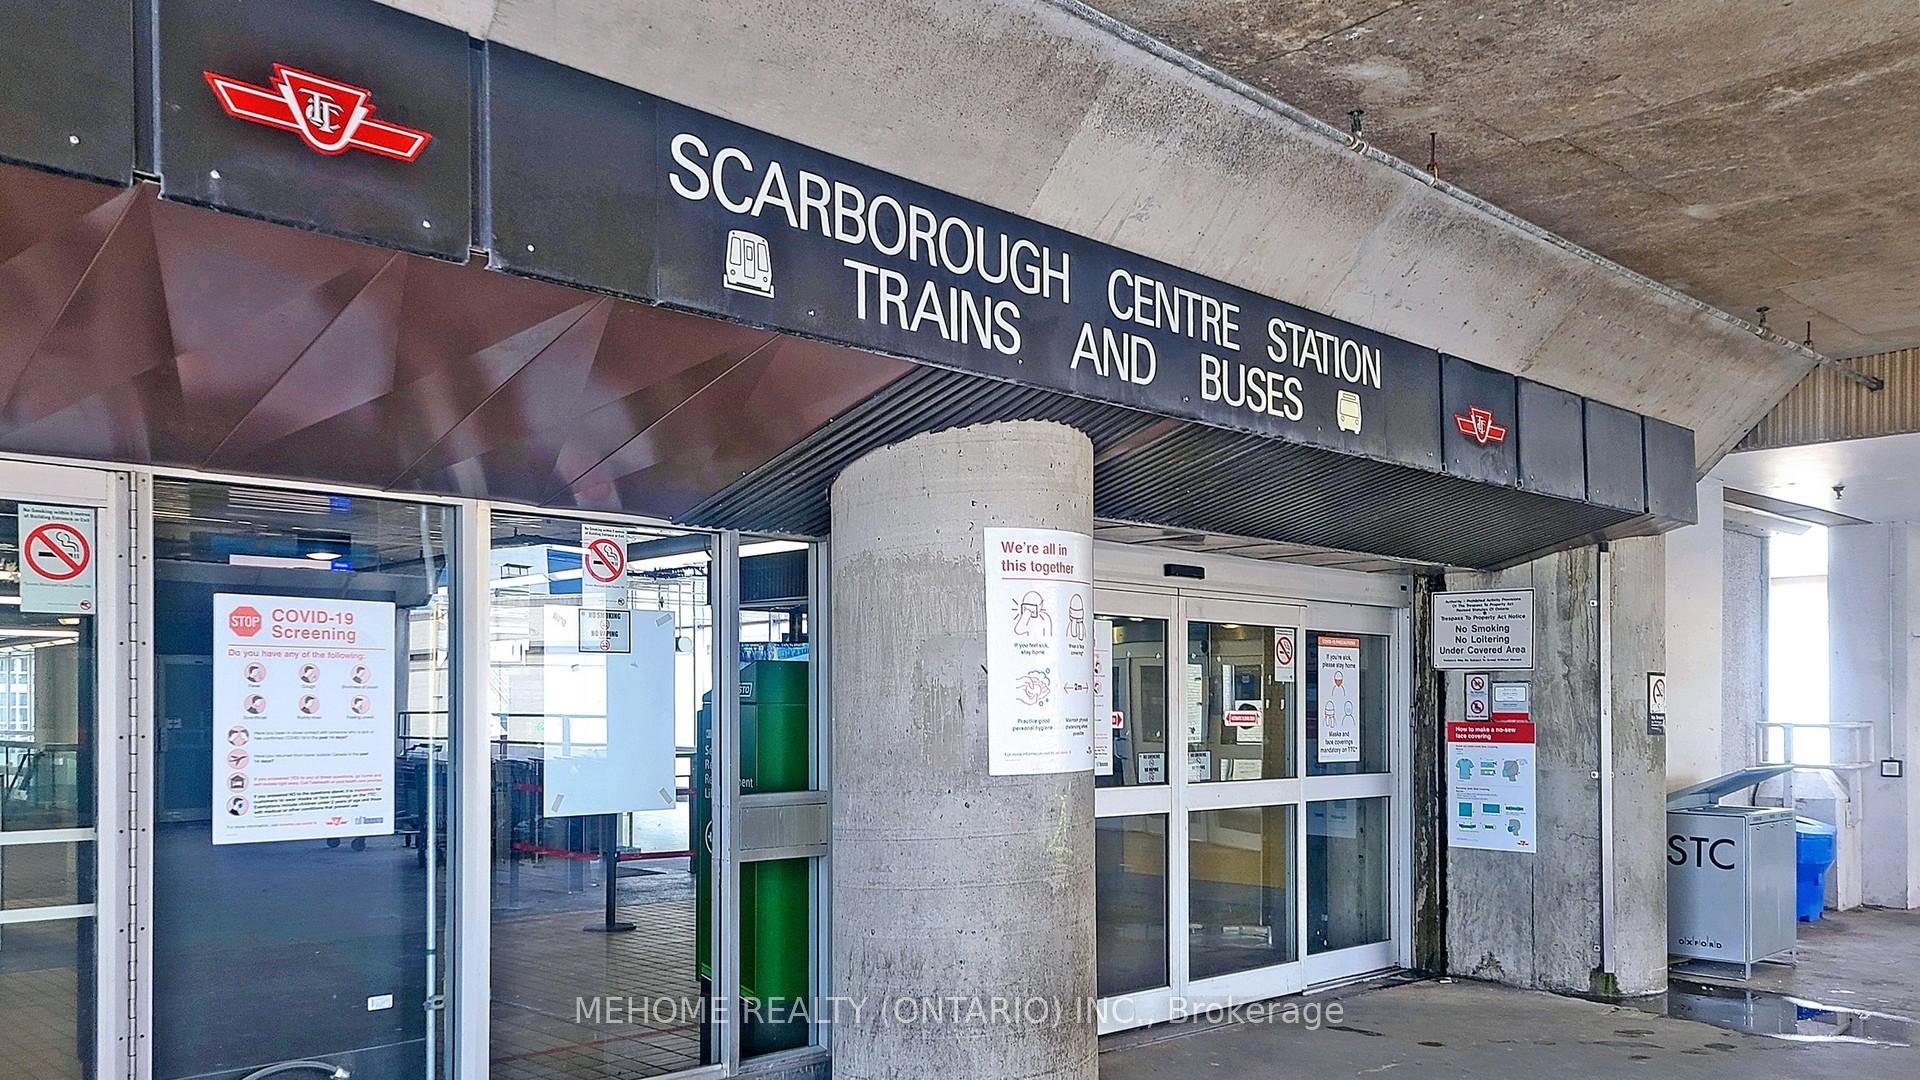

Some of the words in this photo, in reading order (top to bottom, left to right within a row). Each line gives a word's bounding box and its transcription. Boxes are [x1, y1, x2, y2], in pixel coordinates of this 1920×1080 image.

[669, 133, 1070, 304] SCARBOROUGH
[1107, 269, 1241, 351] CENTRE
[1267, 318, 1381, 390] STATION
[843, 258, 1022, 355] TRAINS
[1070, 322, 1158, 386] AND
[1200, 315, 1304, 422] BUSES
[1001, 541, 1039, 554] We're
[1043, 543, 1055, 555] all
[1059, 543, 1067, 556] in
[1001, 560, 1027, 572] this
[1030, 561, 1074, 576] together
[231, 615, 259, 628] STOP
[272, 609, 354, 625] COVID-19
[1473, 614, 1496, 622] Property
[272, 625, 356, 644] Screening
[1455, 625, 1468, 633] No
[1471, 624, 1510, 634] Smoking
[1455, 636, 1468, 644] No
[1471, 635, 1510, 645] Loitering
[228, 649, 241, 657] Do
[243, 650, 260, 660] you
[262, 650, 282, 658] have
[284, 651, 300, 660] any
[302, 650, 311, 658] of
[312, 651, 326, 659] the
[1439, 646, 1464, 655] Under
[1467, 645, 1503, 654] Covered
[1506, 645, 1526, 654] Area
[1667, 835, 1736, 870] STC
[1678, 937, 1722, 949] OXFORD
